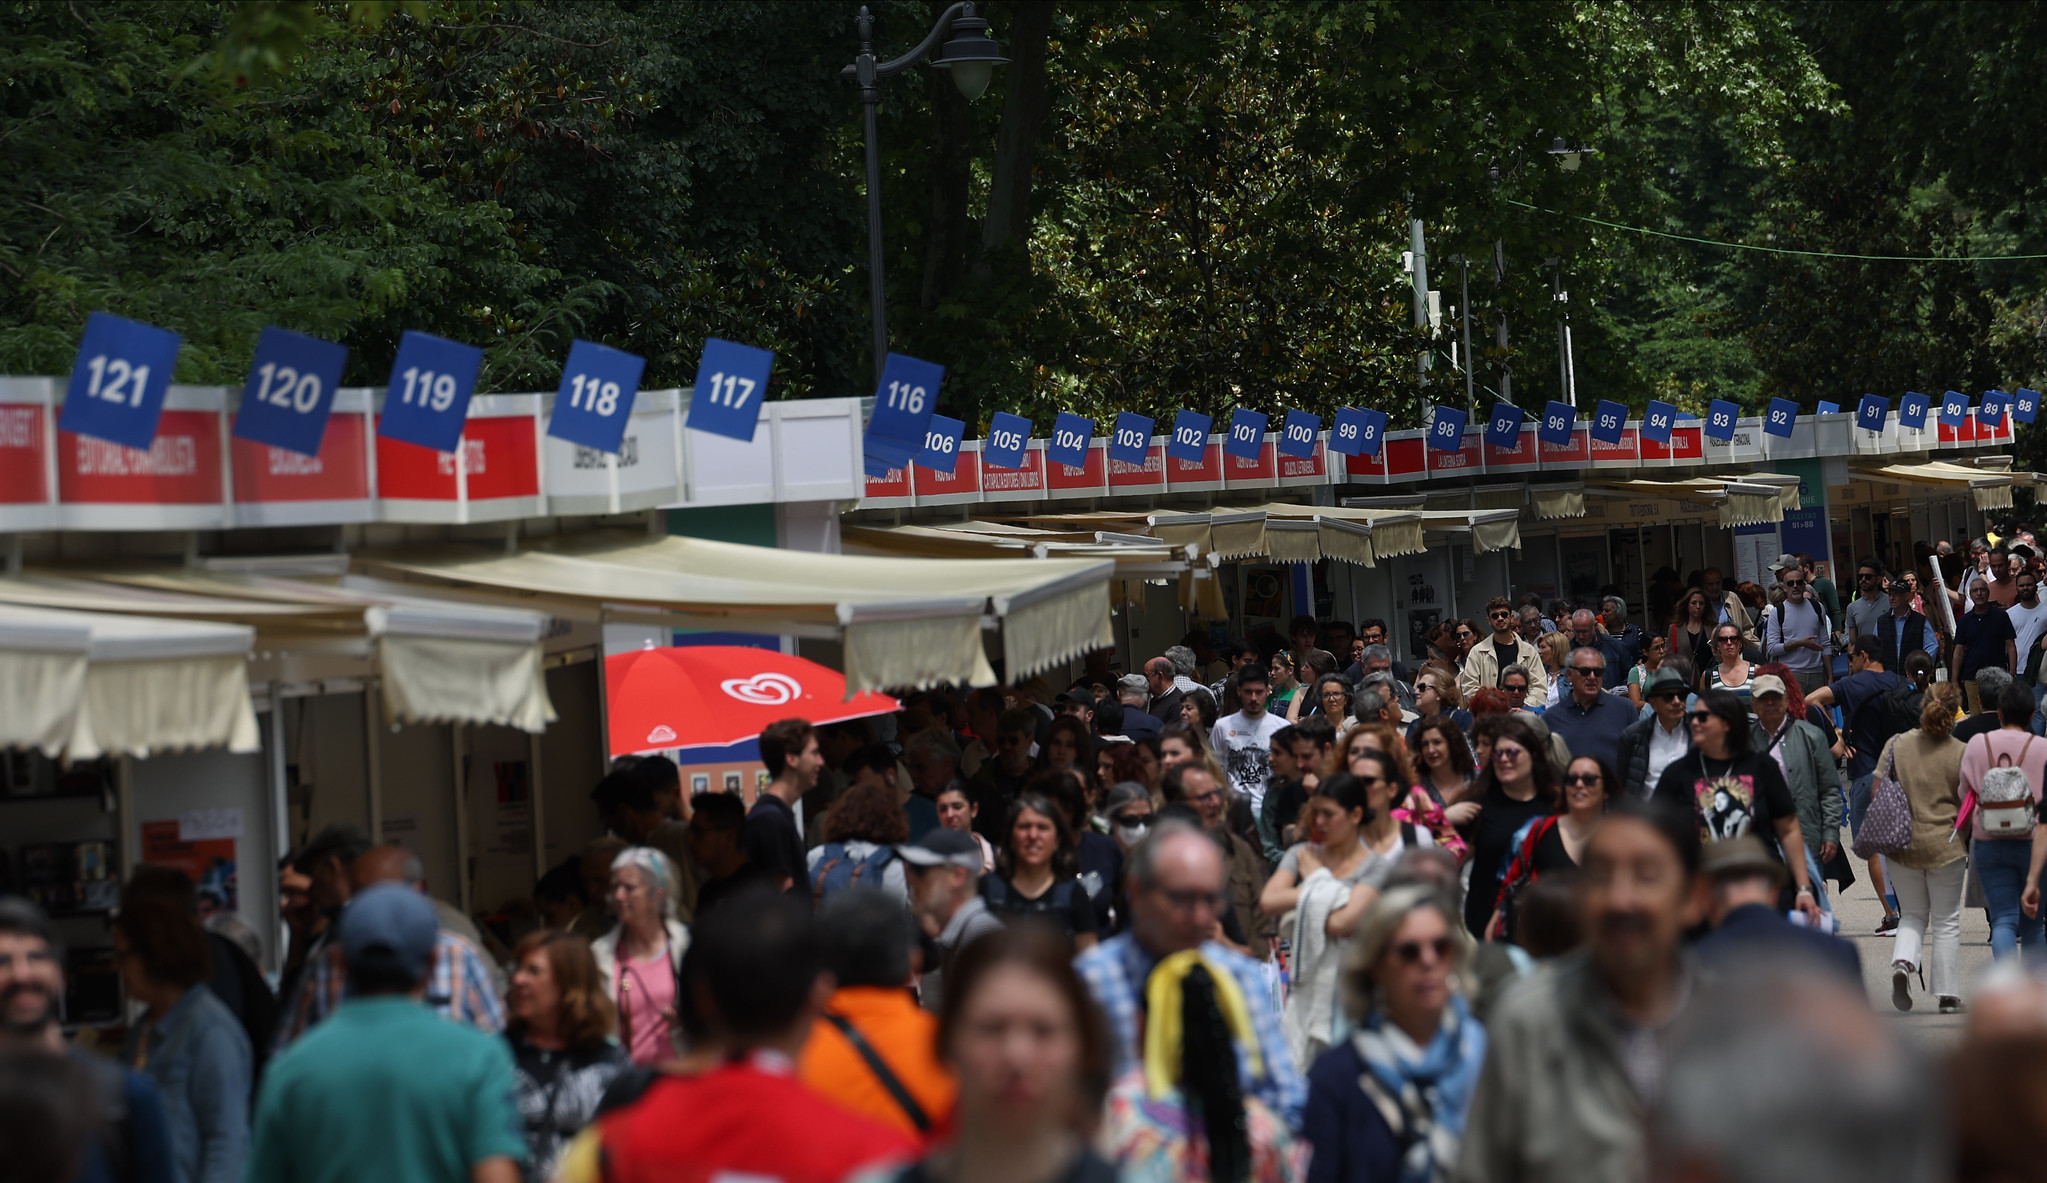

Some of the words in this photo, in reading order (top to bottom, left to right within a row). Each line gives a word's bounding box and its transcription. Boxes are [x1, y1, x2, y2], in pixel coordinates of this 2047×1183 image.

[88, 355, 150, 407] 121
[257, 362, 322, 414] 120
[403, 367, 456, 412] 119
[570, 374, 620, 417] 118
[710, 372, 756, 409] 117
[888, 380, 926, 414] 116
[1866, 405, 1880, 419] 91
[1908, 403, 1921, 417] 91
[1946, 402, 1962, 417] 90
[1984, 402, 1999, 416] 89
[2017, 399, 2033, 413] 88
[1496, 418, 1514, 434] 97
[1548, 415, 1565, 431] 96
[1600, 414, 1617, 430] 95
[1650, 413, 1668, 429] 94
[1712, 412, 1729, 427] 93
[1771, 410, 1787, 425] 92
[1117, 428, 1144, 449] 103
[1176, 426, 1203, 447] 102
[1234, 423, 1257, 443] 101
[1287, 423, 1313, 444] 100
[1339, 422, 1358, 440] 99
[1364, 425, 1375, 440] 8
[1437, 421, 1455, 438] 98
[924, 431, 954, 454] 106
[993, 429, 1022, 451] 105
[1056, 429, 1084, 451] 104
